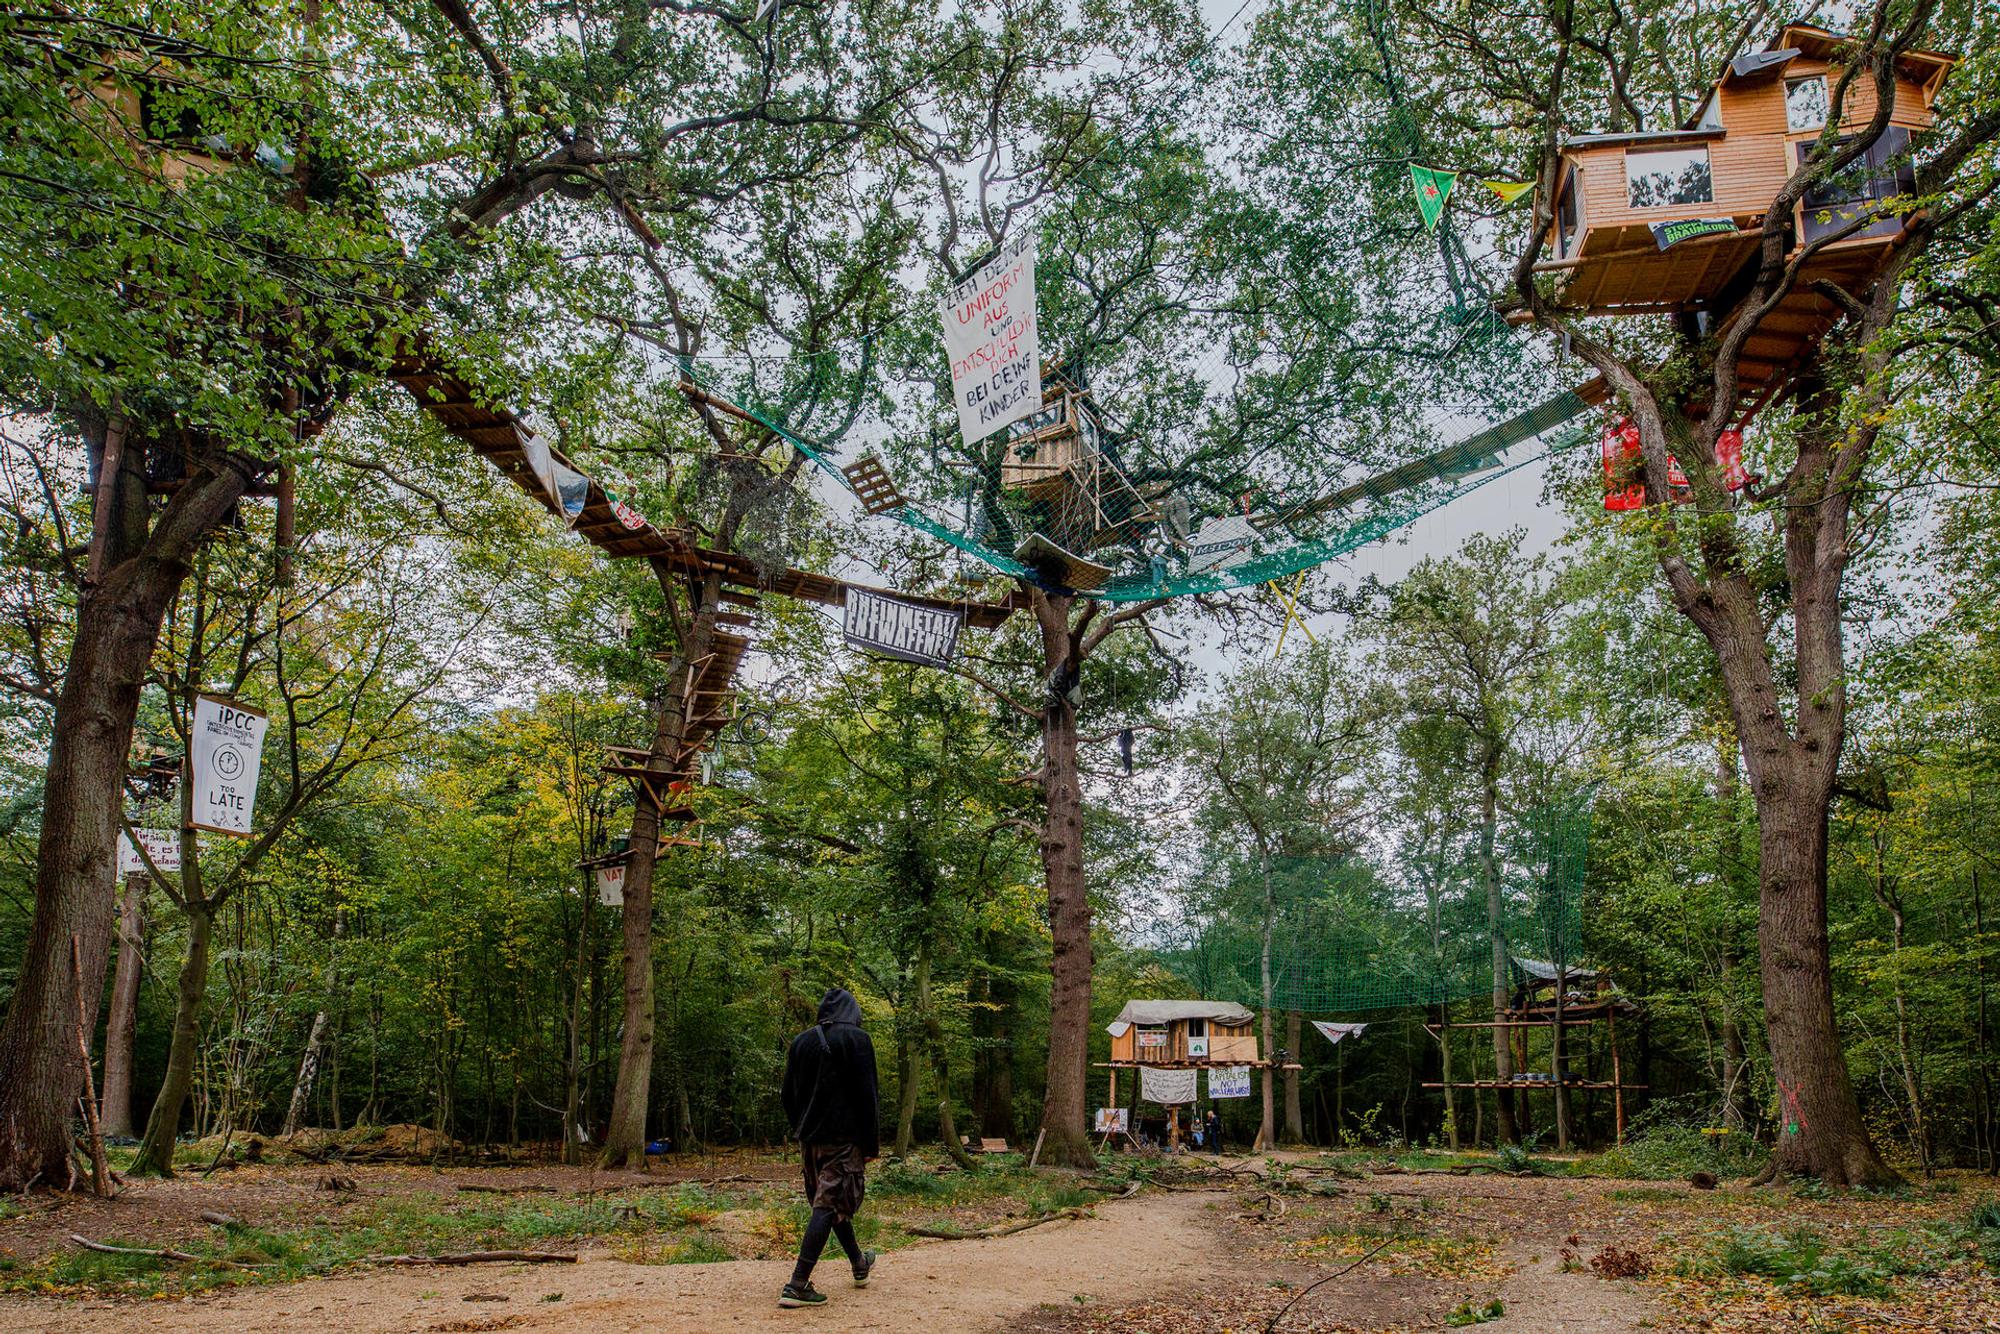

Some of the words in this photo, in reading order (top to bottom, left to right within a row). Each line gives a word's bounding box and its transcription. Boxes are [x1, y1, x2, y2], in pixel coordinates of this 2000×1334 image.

[947, 278, 978, 310] ZIEH
[956, 261, 1024, 324] UNIFORM
[983, 300, 1009, 330] AUS
[991, 315, 1012, 337] UND
[990, 342, 1018, 374] DICH
[966, 382, 988, 407] BEI
[847, 588, 959, 638] RHEINMETALL
[210, 790, 245, 811] LATE
[220, 784, 236, 793] TOO
[1220, 1080, 1237, 1088] NOT
